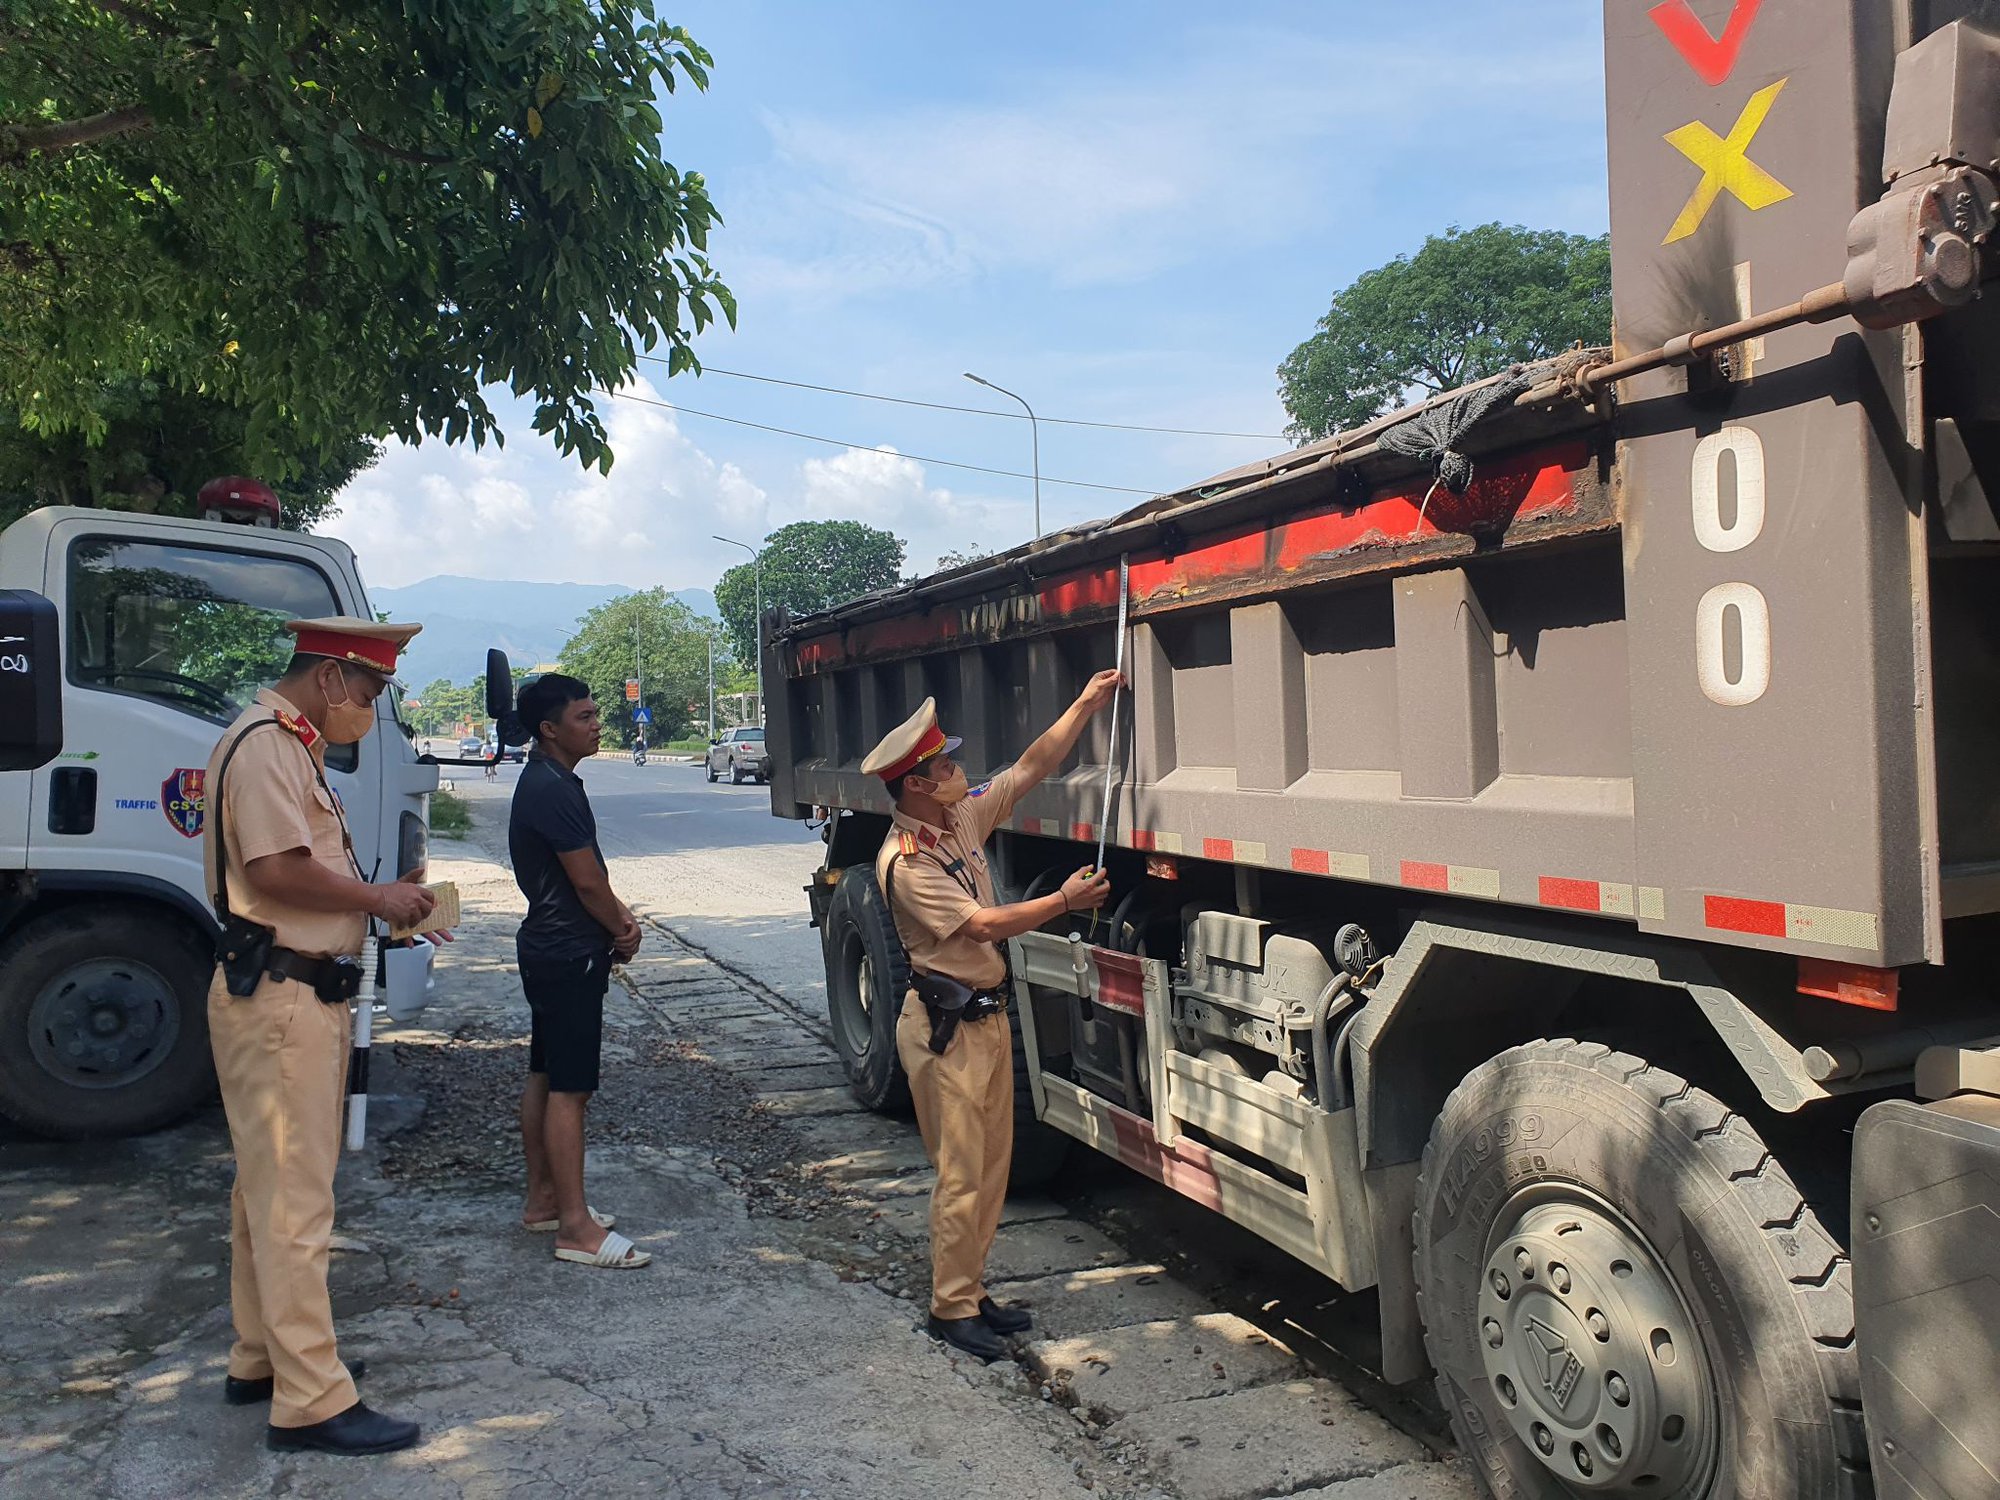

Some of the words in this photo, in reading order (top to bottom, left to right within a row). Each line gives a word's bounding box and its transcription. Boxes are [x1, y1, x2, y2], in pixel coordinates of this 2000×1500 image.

[114, 799, 158, 810] TRAFFIC
[169, 800, 204, 811] CSG
[1440, 1113, 1545, 1217] HA999
